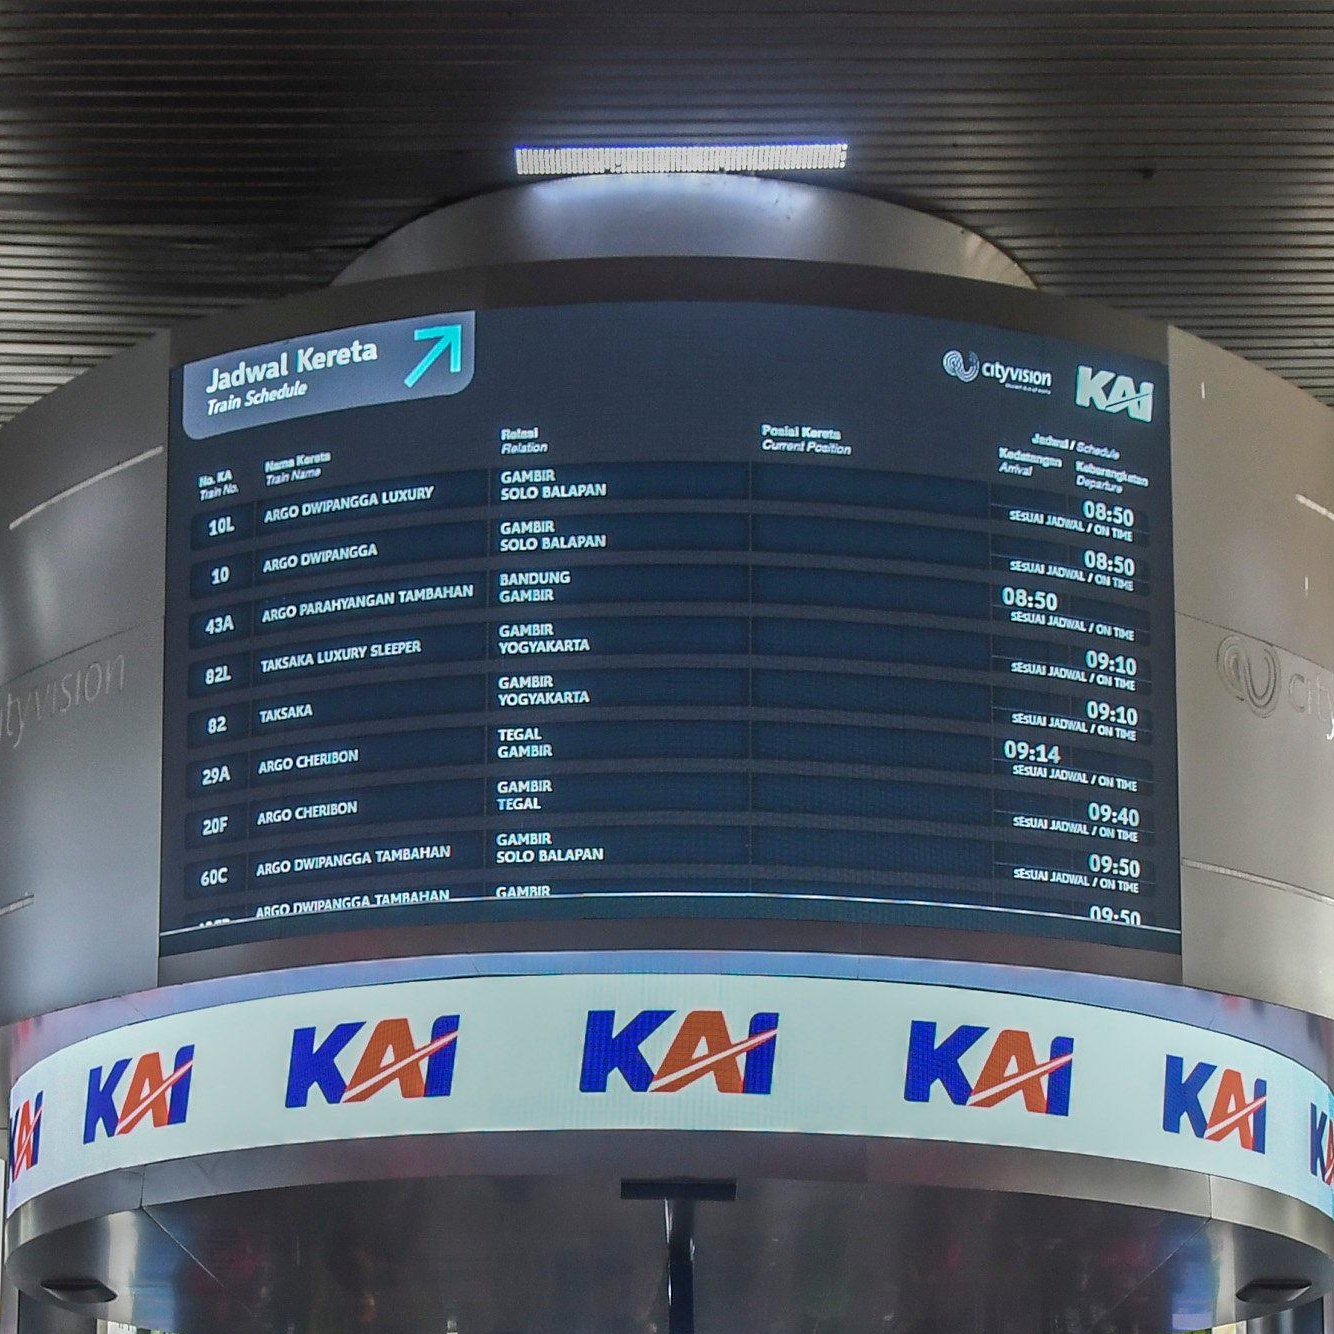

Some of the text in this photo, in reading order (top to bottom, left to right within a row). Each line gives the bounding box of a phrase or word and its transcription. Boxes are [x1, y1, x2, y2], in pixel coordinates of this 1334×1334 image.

[206, 340, 378, 393] Jadwal Kereta
[982, 360, 1052, 388] cityvision
[207, 381, 308, 416] Train Schedule
[1075, 365, 1154, 423] KAI
[296, 451, 332, 467] Kereta
[501, 441, 548, 455] Relation
[762, 439, 852, 455] Current Position
[500, 468, 556, 484] GAMBIR
[999, 462, 1033, 477] Arrival
[500, 483, 607, 500] SOLO BALAPAN
[1076, 475, 1123, 494] Departure
[263, 485, 434, 523] ARGO DWIPANGGA LUXURY
[1083, 500, 1134, 527] 08:50
[208, 517, 235, 537] 10L
[1045, 515, 1109, 537] JADWAL ON
[1084, 550, 1135, 576] 08:50
[1002, 586, 1058, 611] 08:50
[1085, 649, 1137, 676] 09:10
[1086, 700, 1138, 727] 09:10
[1004, 740, 1061, 764] 09:14
[1088, 803, 1140, 828] 09:40
[1088, 854, 1141, 879] 09:50
[82, 1009, 1268, 1155] KAI KAI KAI KAI KAI
